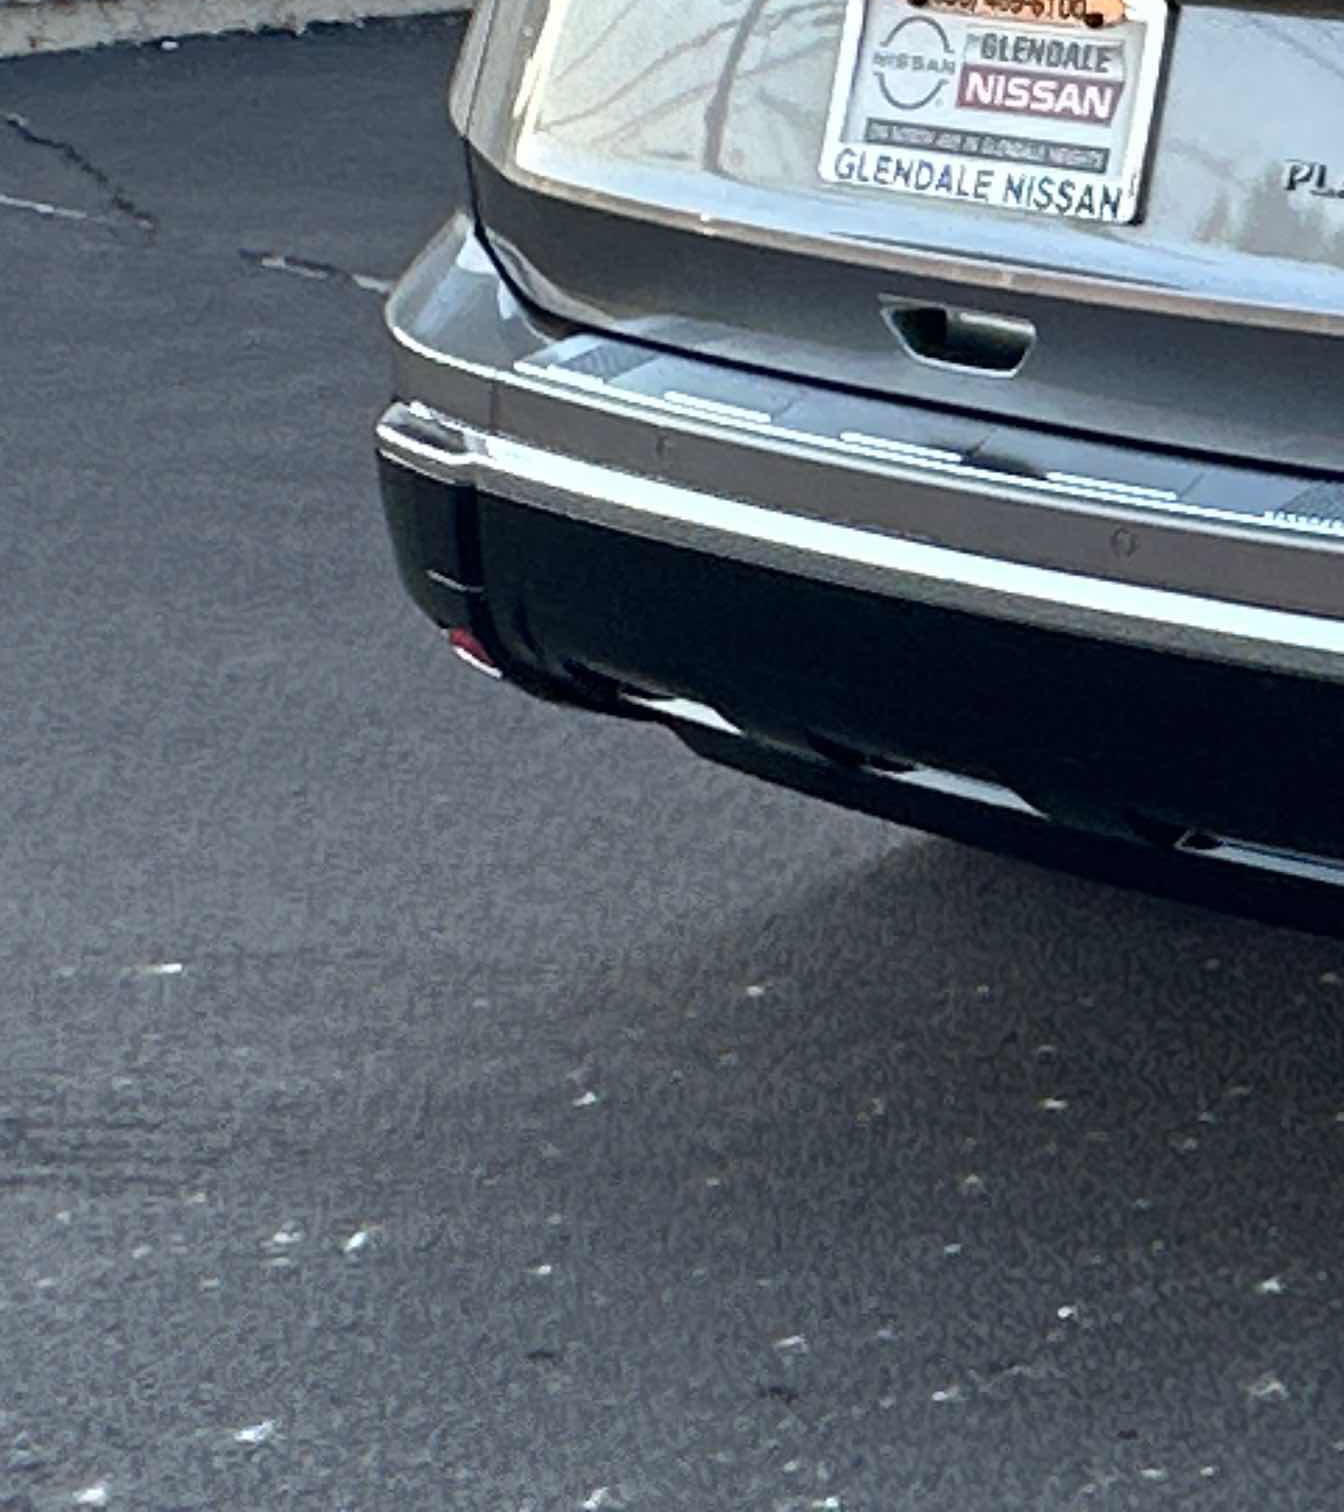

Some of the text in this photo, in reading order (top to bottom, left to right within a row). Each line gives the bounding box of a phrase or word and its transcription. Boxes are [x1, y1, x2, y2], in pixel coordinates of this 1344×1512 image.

[872, 50, 956, 75] NISSAN
[979, 32, 1113, 73] GLENDALE
[964, 74, 1113, 120] NISSAN
[834, 148, 1122, 221] GLENDALE NISSAN
